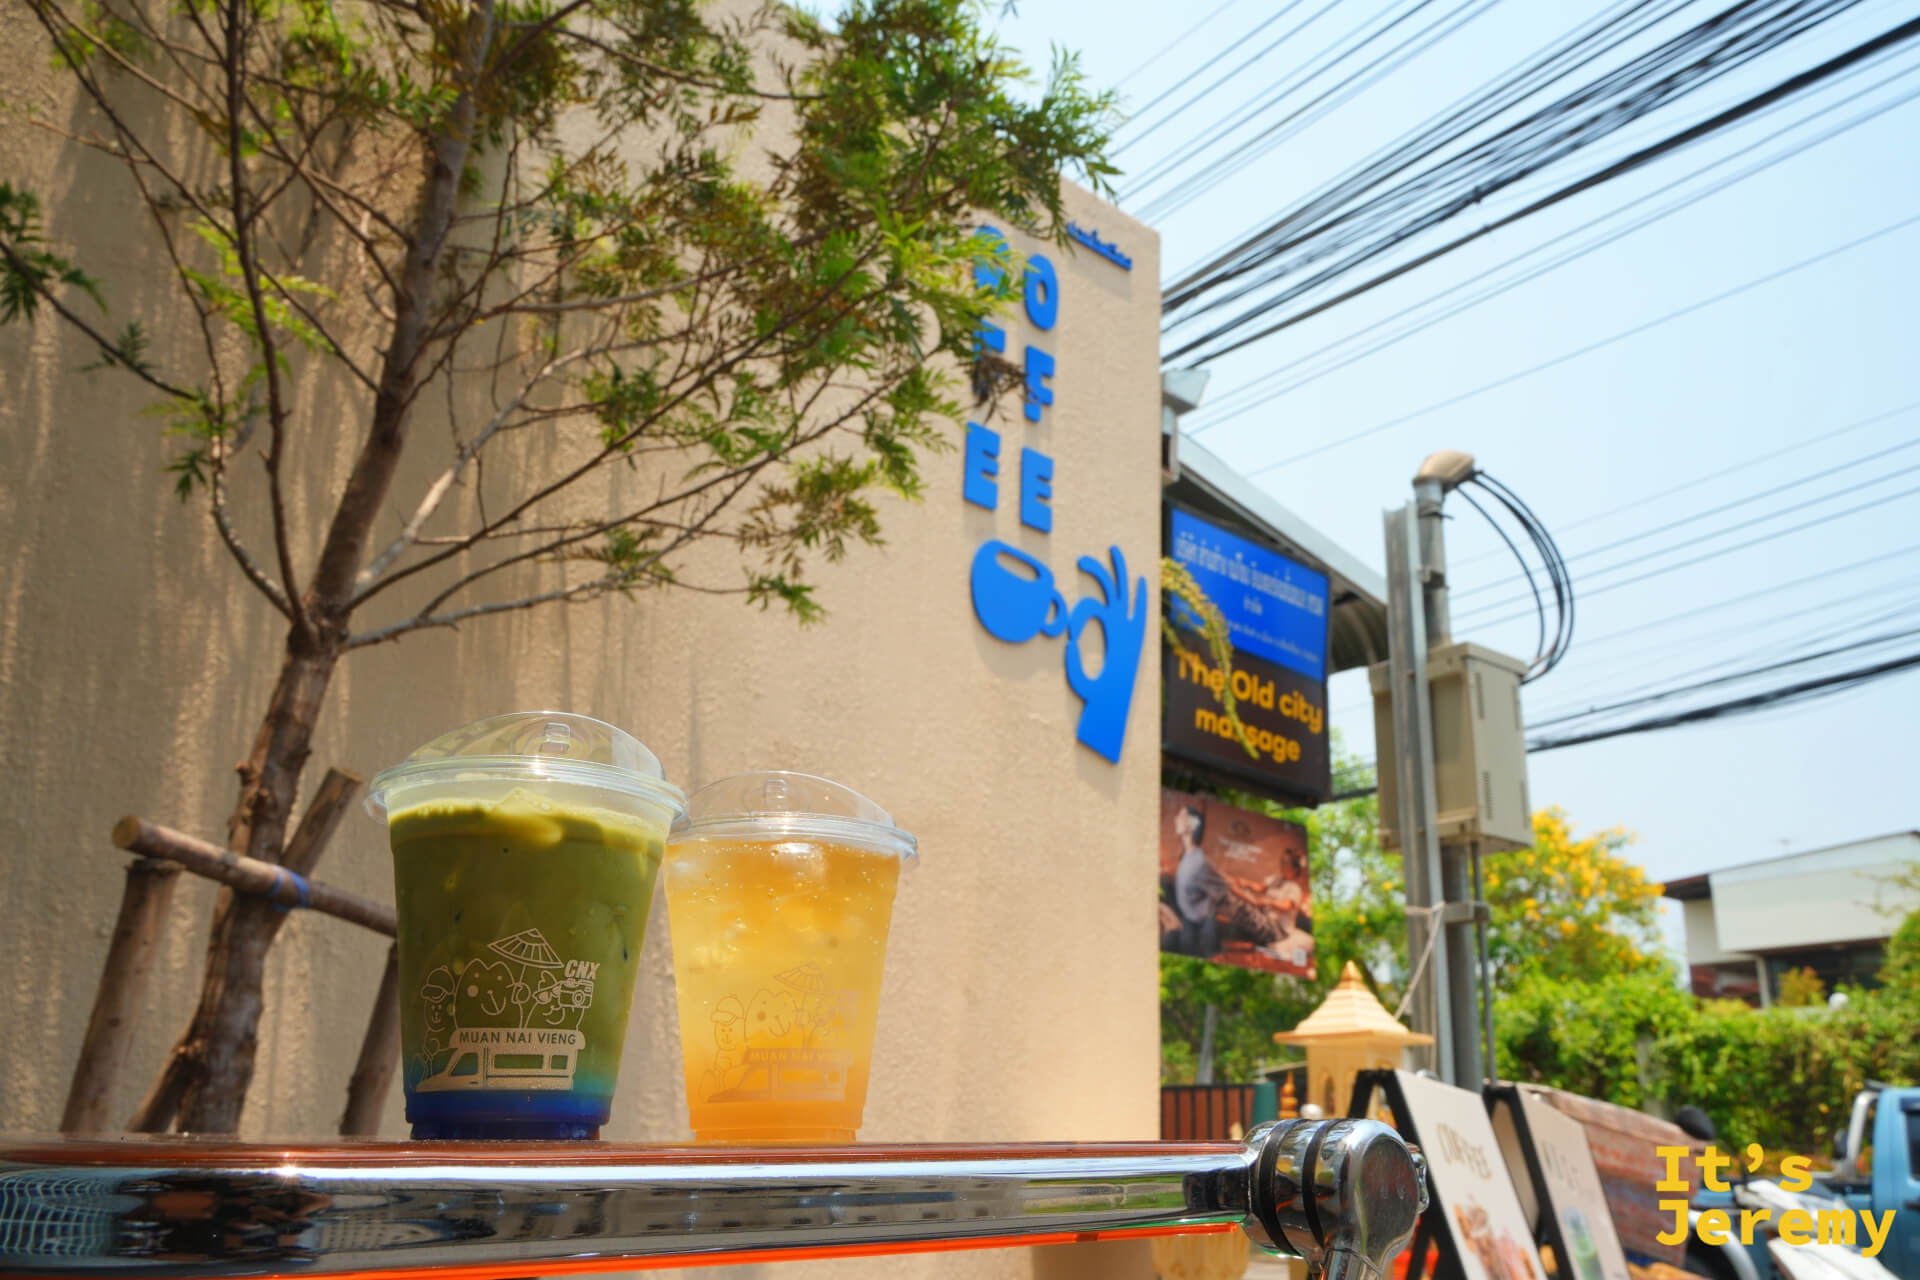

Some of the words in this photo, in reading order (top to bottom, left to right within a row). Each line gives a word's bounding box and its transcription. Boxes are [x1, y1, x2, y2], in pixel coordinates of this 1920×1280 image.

[1231, 669, 1275, 710] Old
[1279, 690, 1323, 735] city
[564, 959, 600, 980] CNX
[459, 1031, 500, 1044] MUAN
[506, 1031, 532, 1044] NAI
[538, 1032, 577, 1045] VIENG
